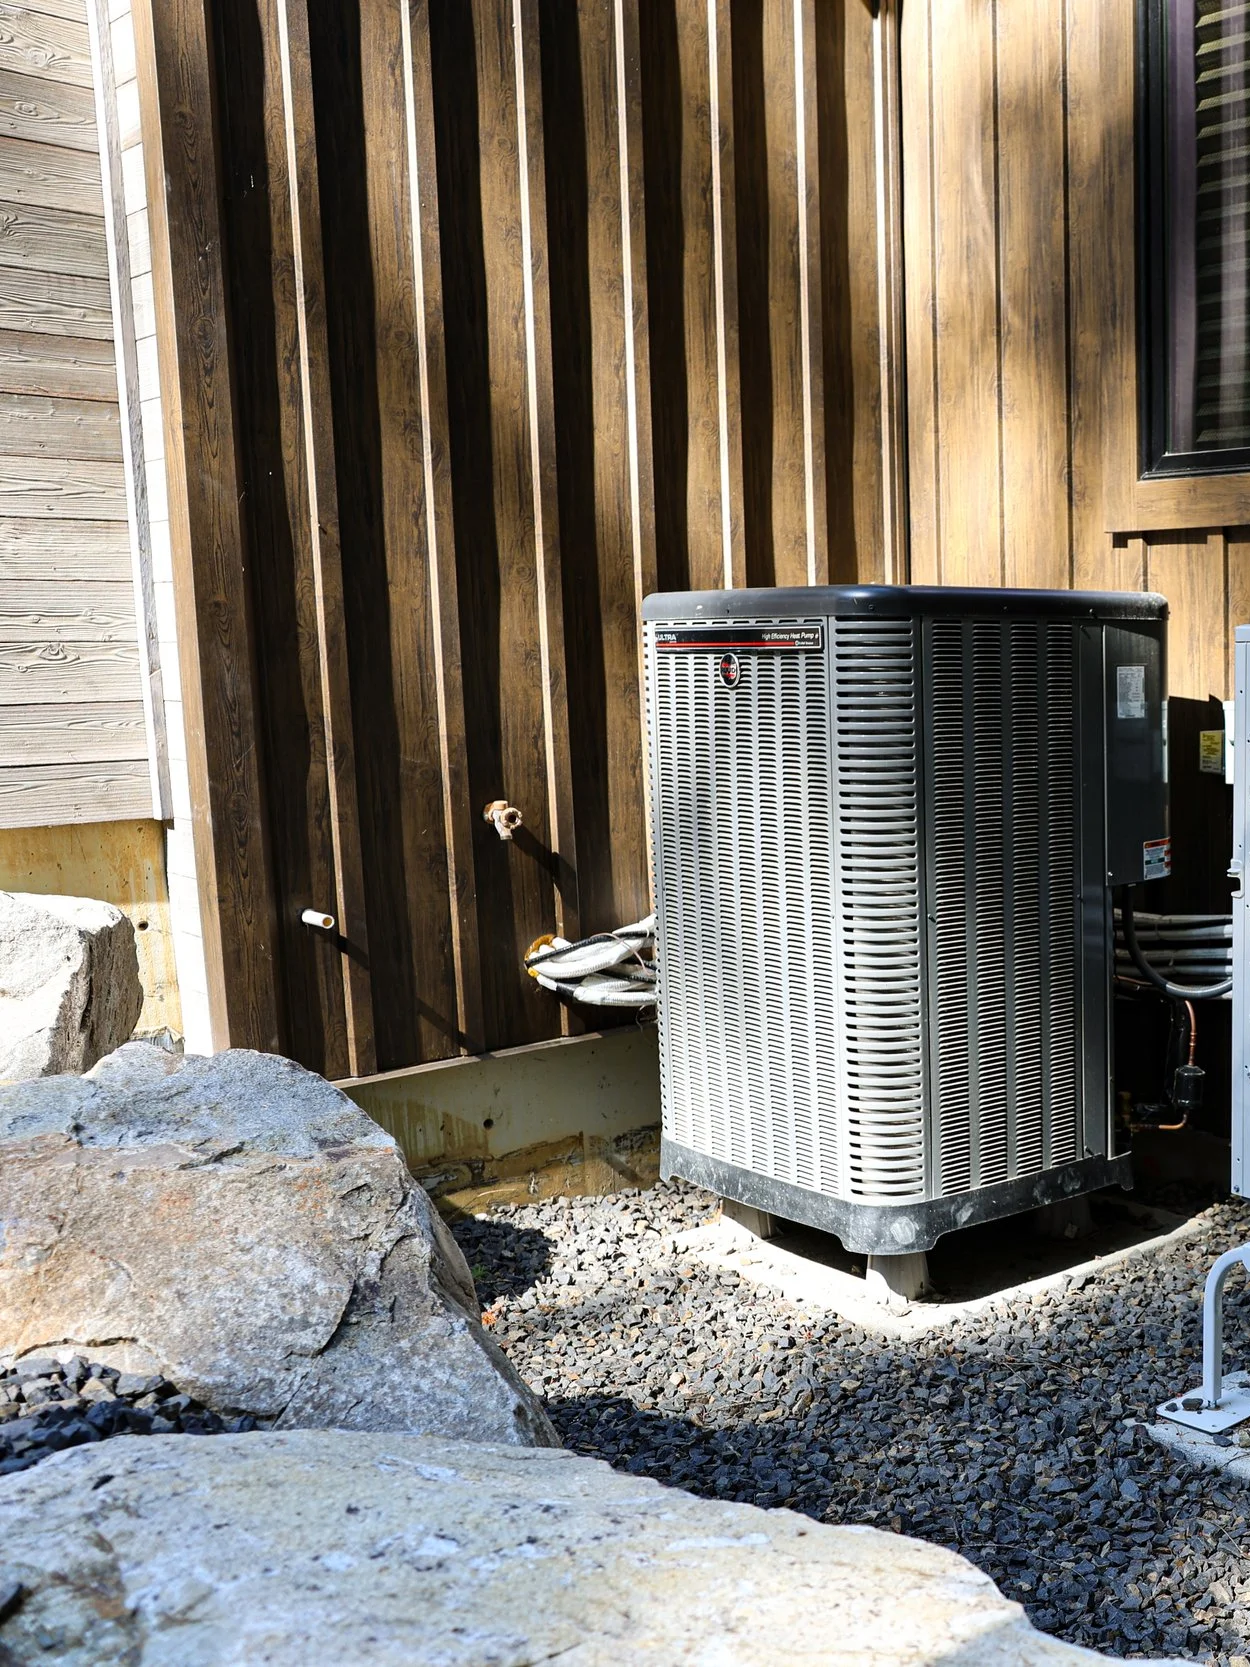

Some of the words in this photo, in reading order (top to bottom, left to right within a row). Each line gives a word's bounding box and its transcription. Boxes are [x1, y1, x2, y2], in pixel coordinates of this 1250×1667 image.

[657, 633, 677, 641] ULTRA
[761, 633, 771, 641] High
[771, 632, 790, 641] Efficiency
[790, 632, 801, 640] Heat
[801, 631, 814, 640] Pump
